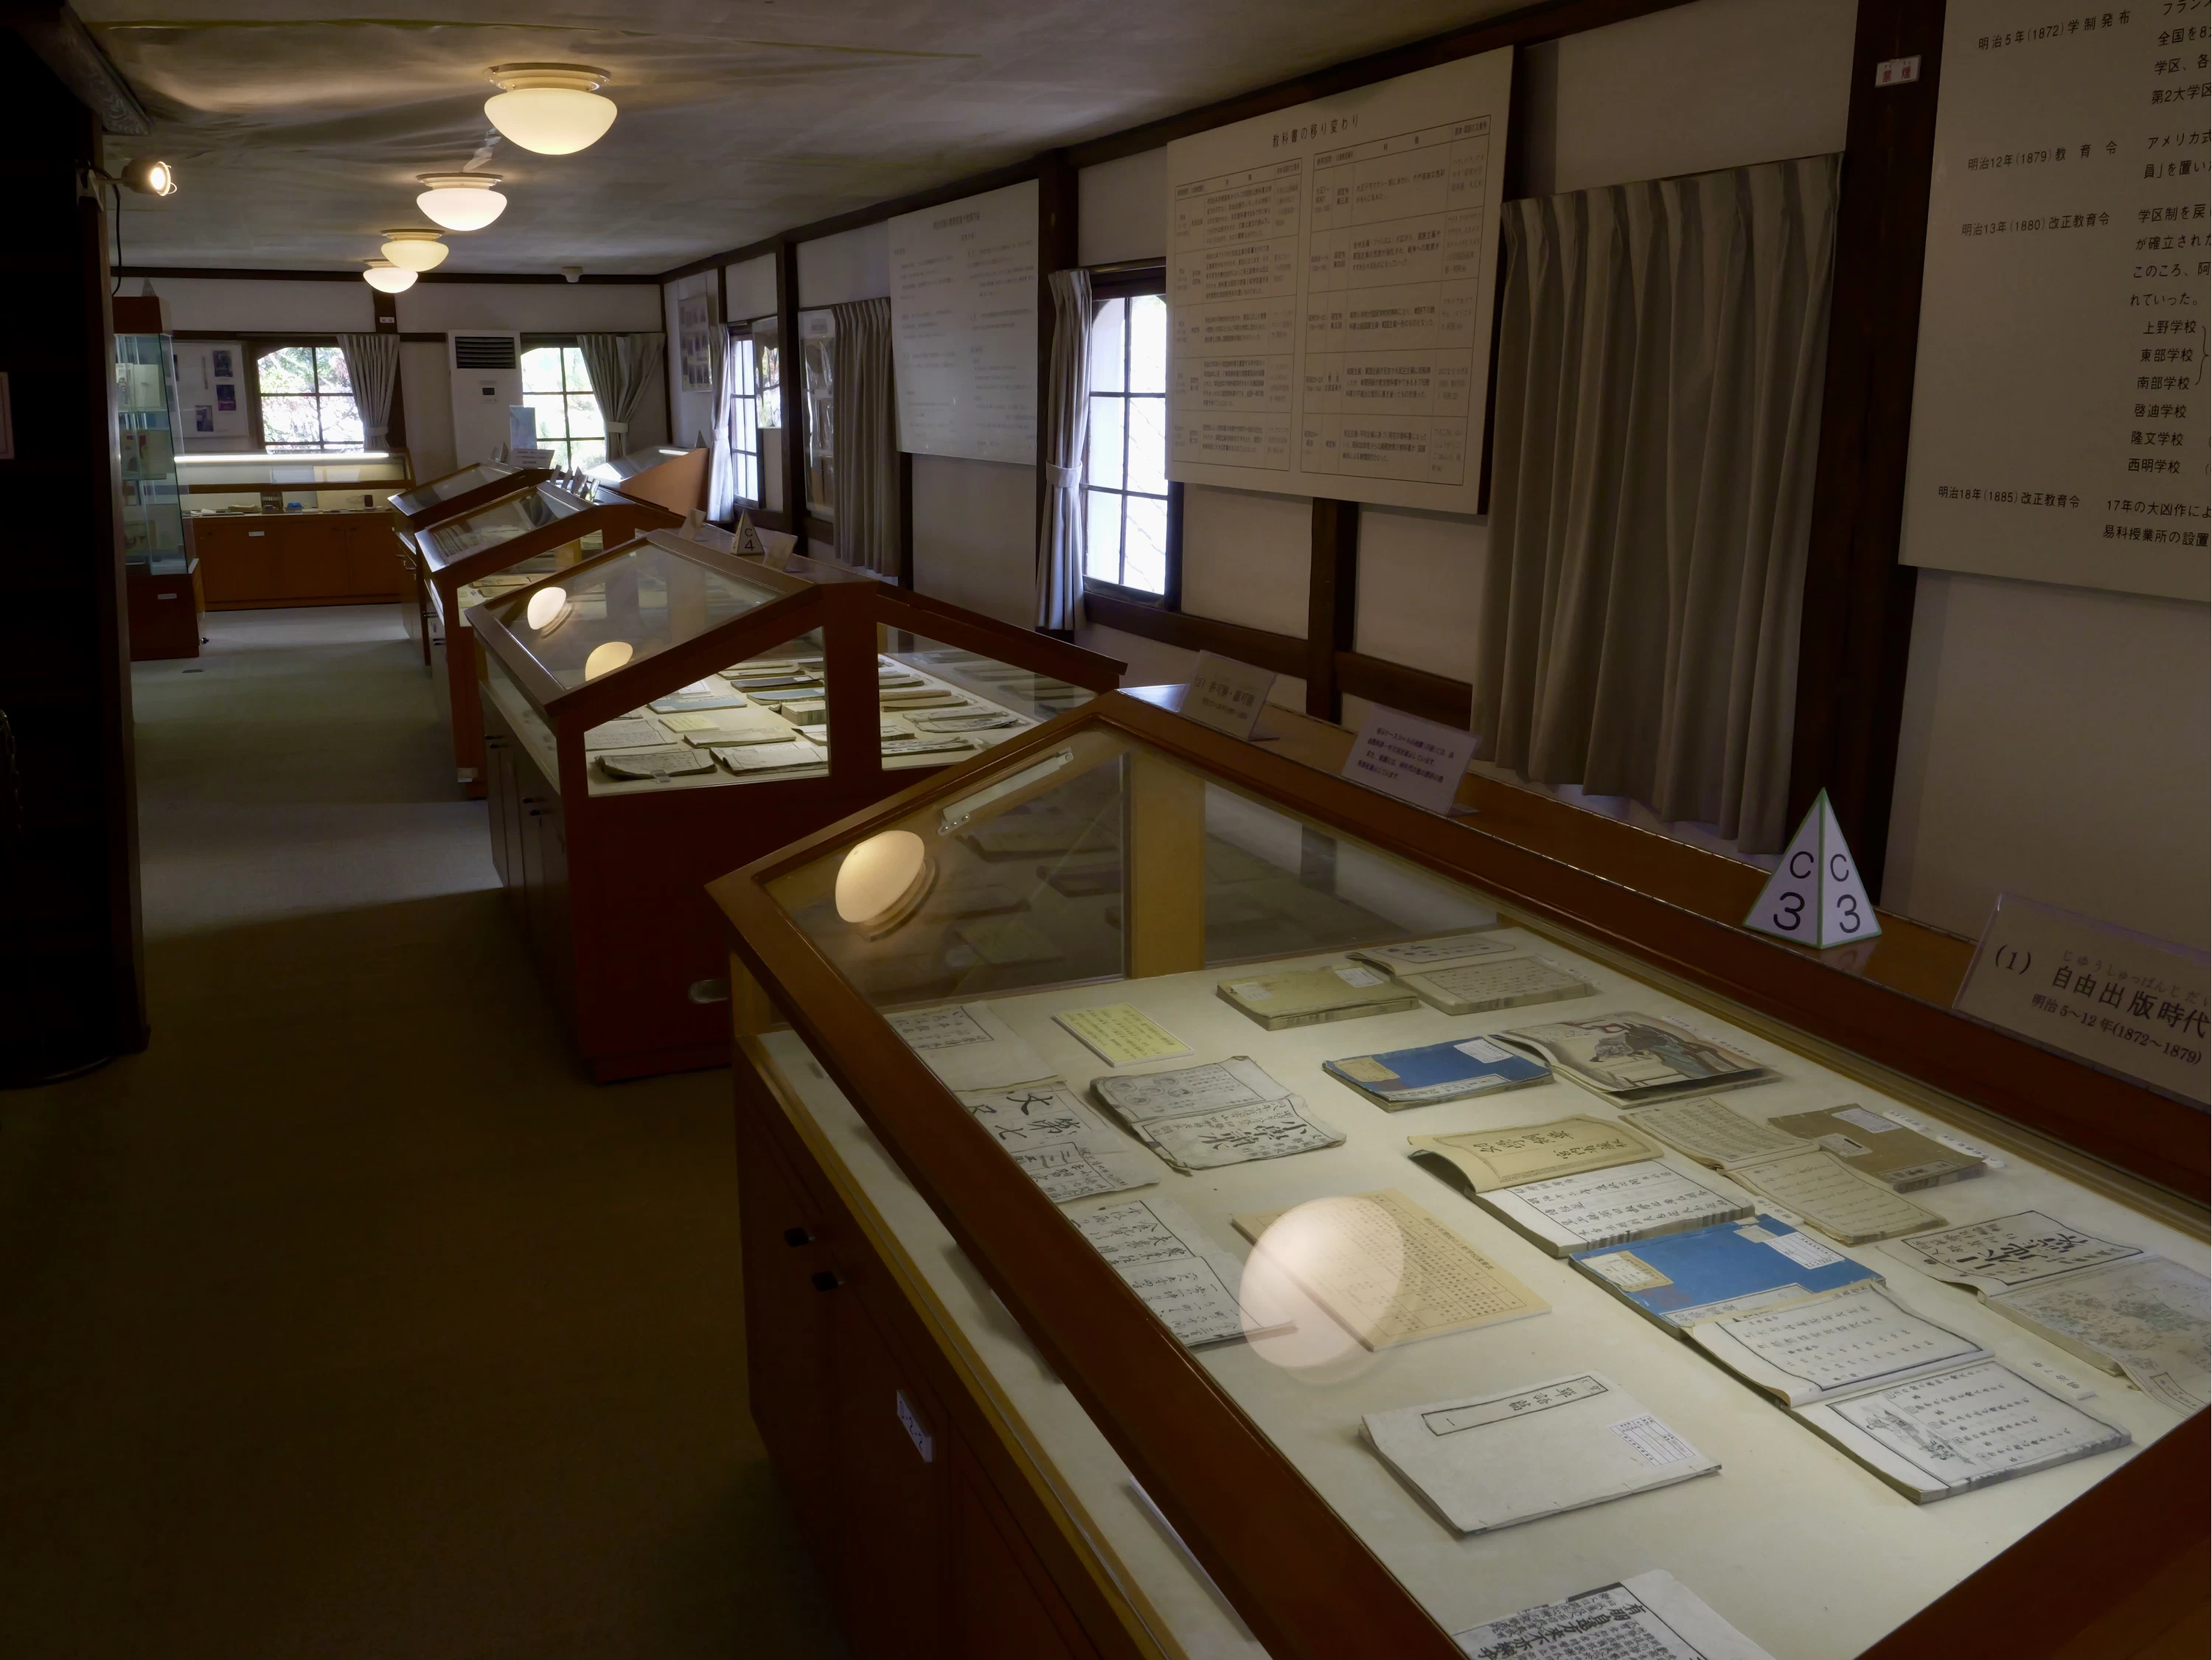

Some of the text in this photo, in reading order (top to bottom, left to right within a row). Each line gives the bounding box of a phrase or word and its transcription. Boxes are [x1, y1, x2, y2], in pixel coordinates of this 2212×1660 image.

[2157, 27, 2211, 46] 全国を8
[2154, 54, 2210, 76] 学区、各
[2152, 83, 2211, 105] 第2大学区
[1272, 114, 1360, 148] 教科書の移り変わり
[2148, 131, 2211, 152] アメリカ式
[2143, 160, 2211, 178] 員」を置い
[2138, 203, 2211, 223] 学区制を戻
[2129, 292, 2199, 307] れていった。
[2143, 319, 2197, 335] 上野学校
[2140, 347, 2194, 363] 東部学校
[2137, 375, 2191, 391] 南部学校
[2134, 403, 2187, 419] 啓迪学校
[2131, 430, 2184, 447] 隆文学校
[2127, 458, 2180, 475] 西明学校
[2102, 525, 2209, 547] 易科授業所の設置
[1790, 851, 1814, 879] C
[1830, 854, 1848, 882] C
[1773, 892, 1805, 931] 3
[1837, 894, 1860, 933] 3
[2052, 965, 2210, 1039] 自由出版時代
